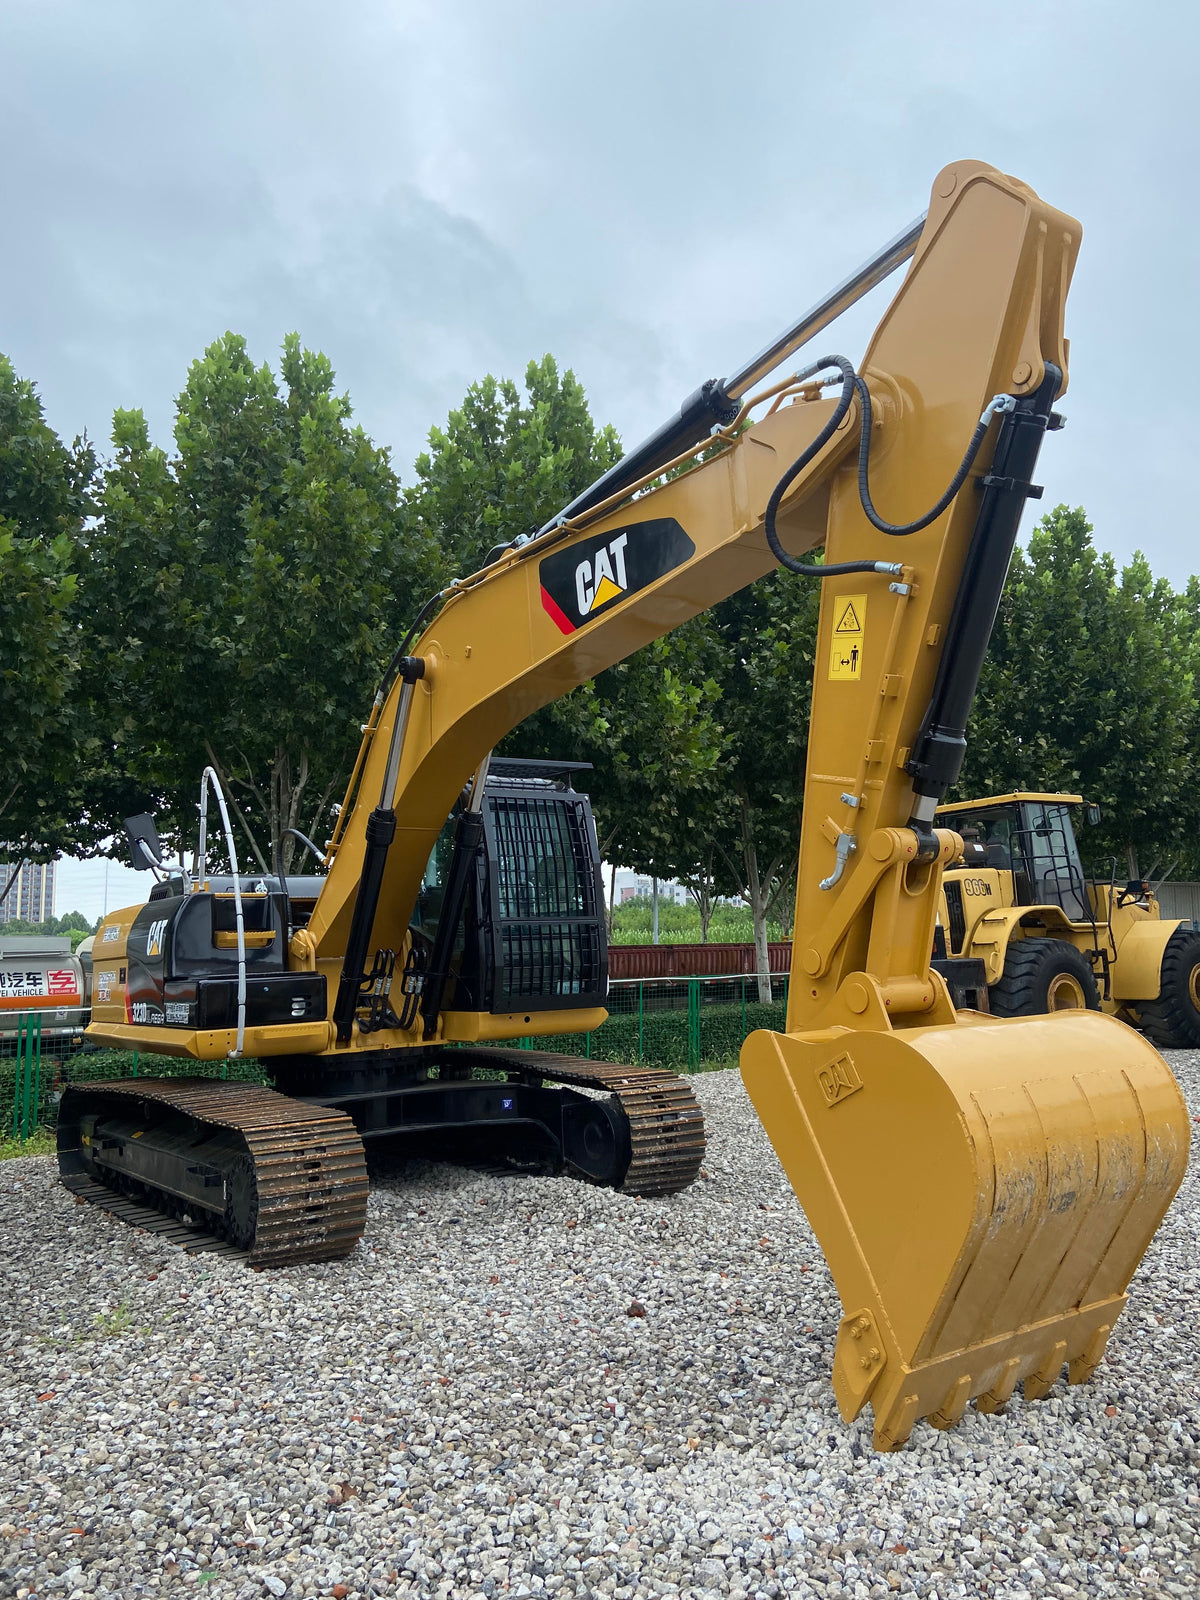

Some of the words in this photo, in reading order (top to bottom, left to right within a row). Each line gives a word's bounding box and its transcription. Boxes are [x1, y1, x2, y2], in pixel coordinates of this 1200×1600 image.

[575, 532, 628, 616] CAT
[963, 878, 992, 896] 966H
[147, 919, 168, 956] CAT
[12, 988, 43, 997] VEHICLE
[819, 1056, 854, 1102] CAT
